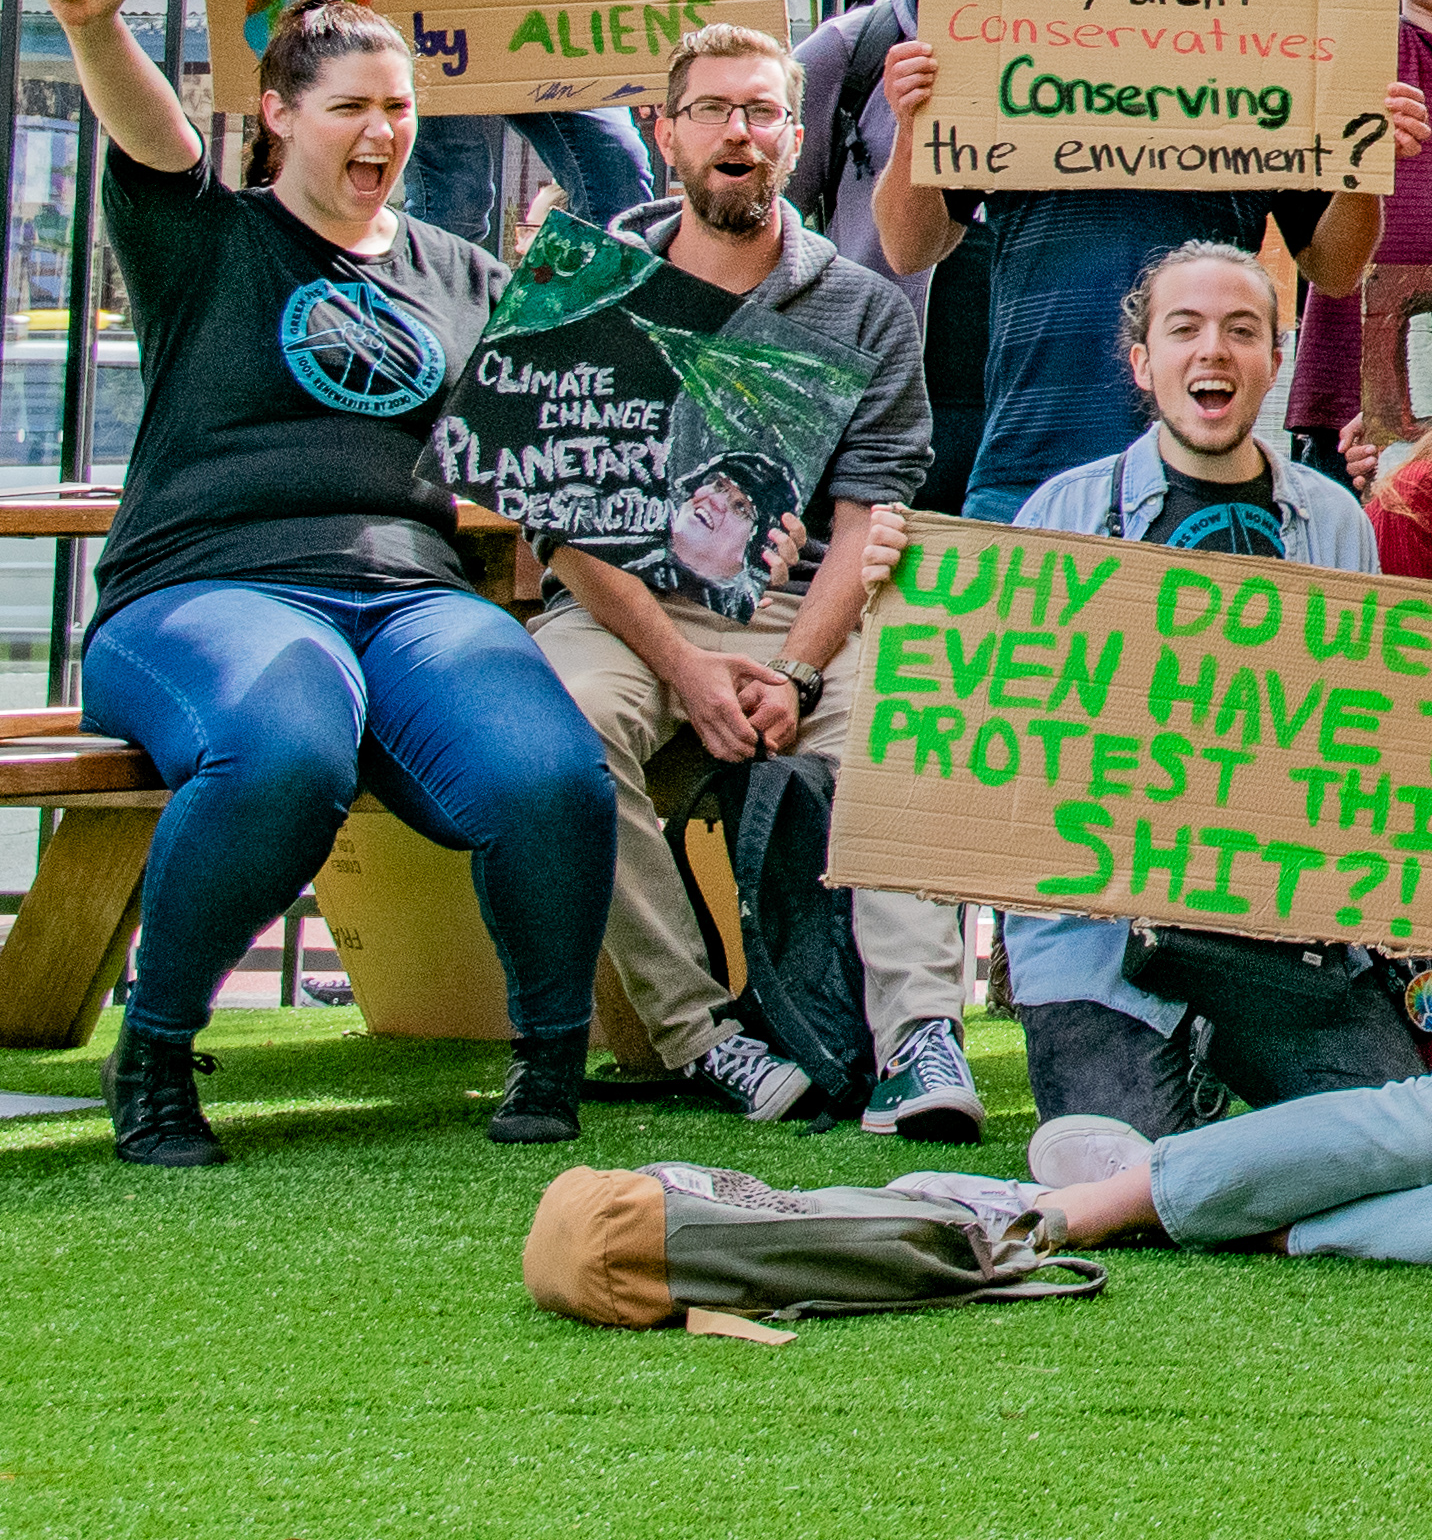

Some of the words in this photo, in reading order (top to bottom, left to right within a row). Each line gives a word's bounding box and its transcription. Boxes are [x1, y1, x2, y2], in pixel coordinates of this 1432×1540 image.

[412, 13, 469, 76] by
[948, 3, 1337, 61] Conservatives
[1000, 54, 1292, 130] Conserving
[925, 120, 1017, 175] the
[478, 350, 614, 398] CLIMATE
[538, 399, 664, 430] CHANGE
[433, 416, 675, 488] PLANETARY
[900, 545, 1120, 626] WHY
[1157, 568, 1281, 646] DO
[874, 624, 1124, 716] EVEN
[1147, 646, 1392, 765] HAVE
[868, 700, 1255, 806] PROTEST
[1036, 802, 1420, 938] SHIT?!
